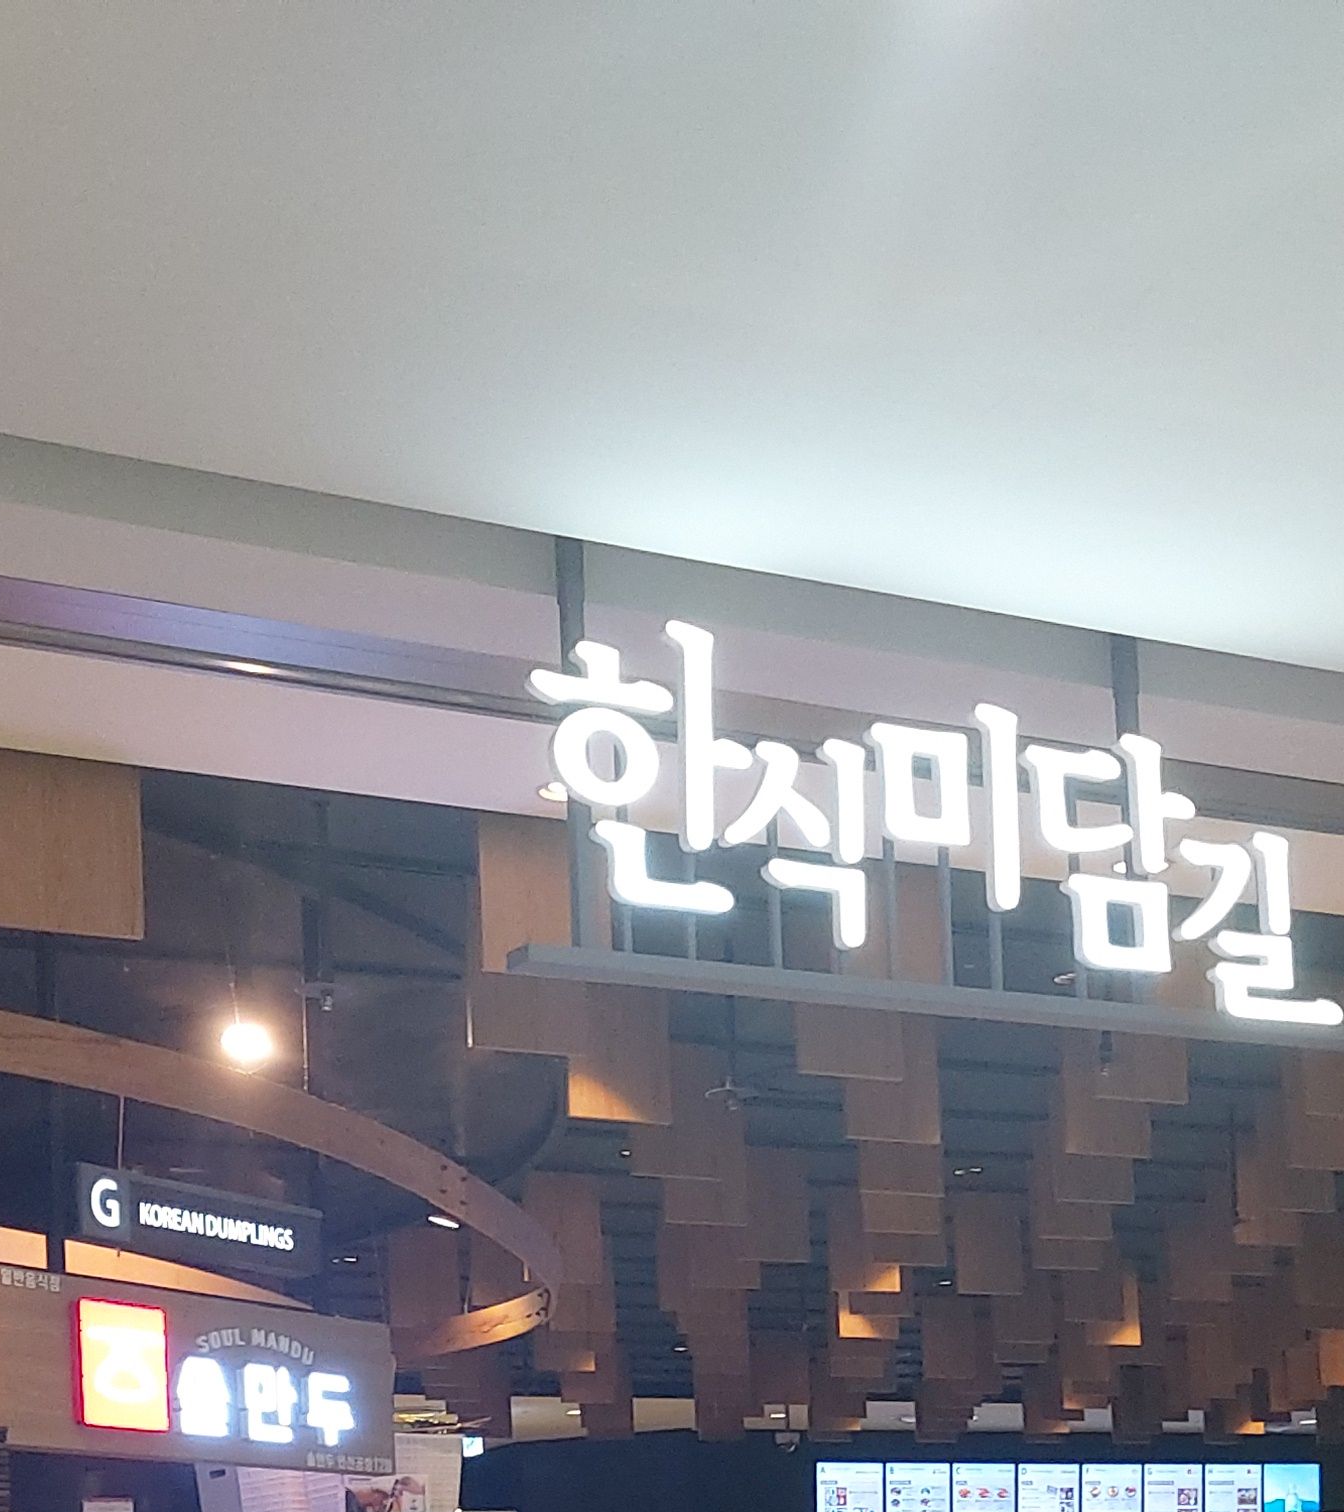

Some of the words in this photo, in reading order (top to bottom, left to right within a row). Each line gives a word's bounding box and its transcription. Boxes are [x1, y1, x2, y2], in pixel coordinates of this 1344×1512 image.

[526, 620, 1344, 1027] 한식미담길
[90, 1178, 121, 1227] G
[139, 1202, 205, 1235] KOREAN
[206, 1214, 294, 1250] DUMPLINGS
[1, 1268, 61, 1292] 일반음식점
[196, 1328, 246, 1352] SOUL
[251, 1329, 314, 1365] MANDU
